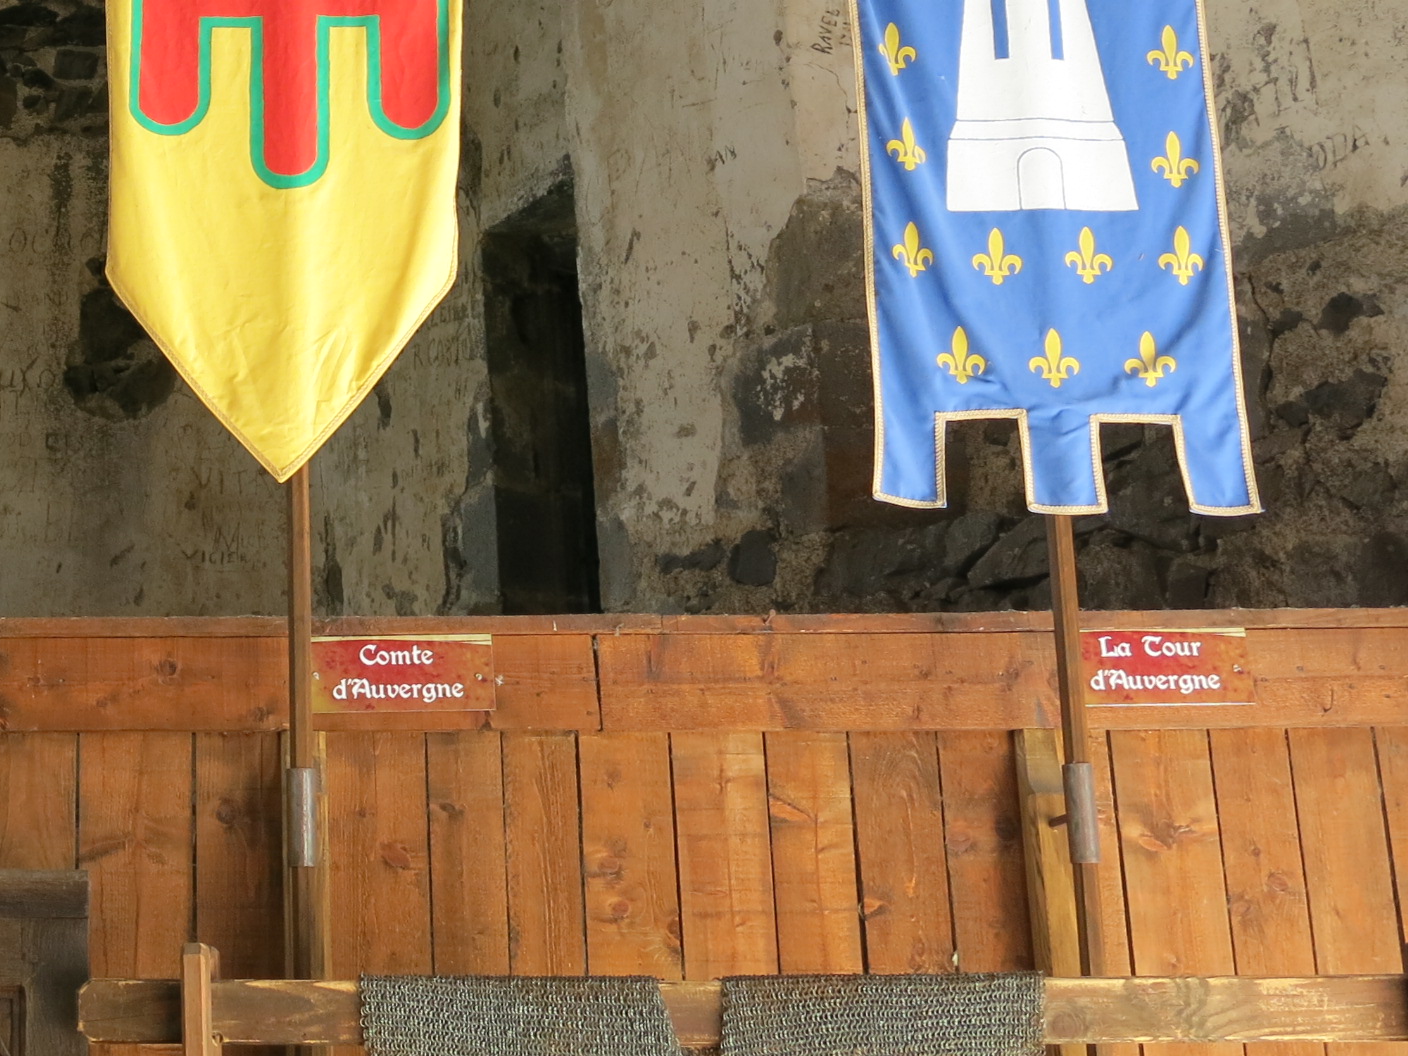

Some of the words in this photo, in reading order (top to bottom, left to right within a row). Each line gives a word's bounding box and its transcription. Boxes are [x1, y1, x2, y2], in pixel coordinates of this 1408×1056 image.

[810, 8, 841, 55] RAVEL
[358, 644, 434, 666] Comte
[1097, 635, 1133, 658] La
[1141, 635, 1202, 657] Tour
[332, 677, 465, 704] d'Auvergne
[1090, 668, 1221, 695] d'Auvergne
